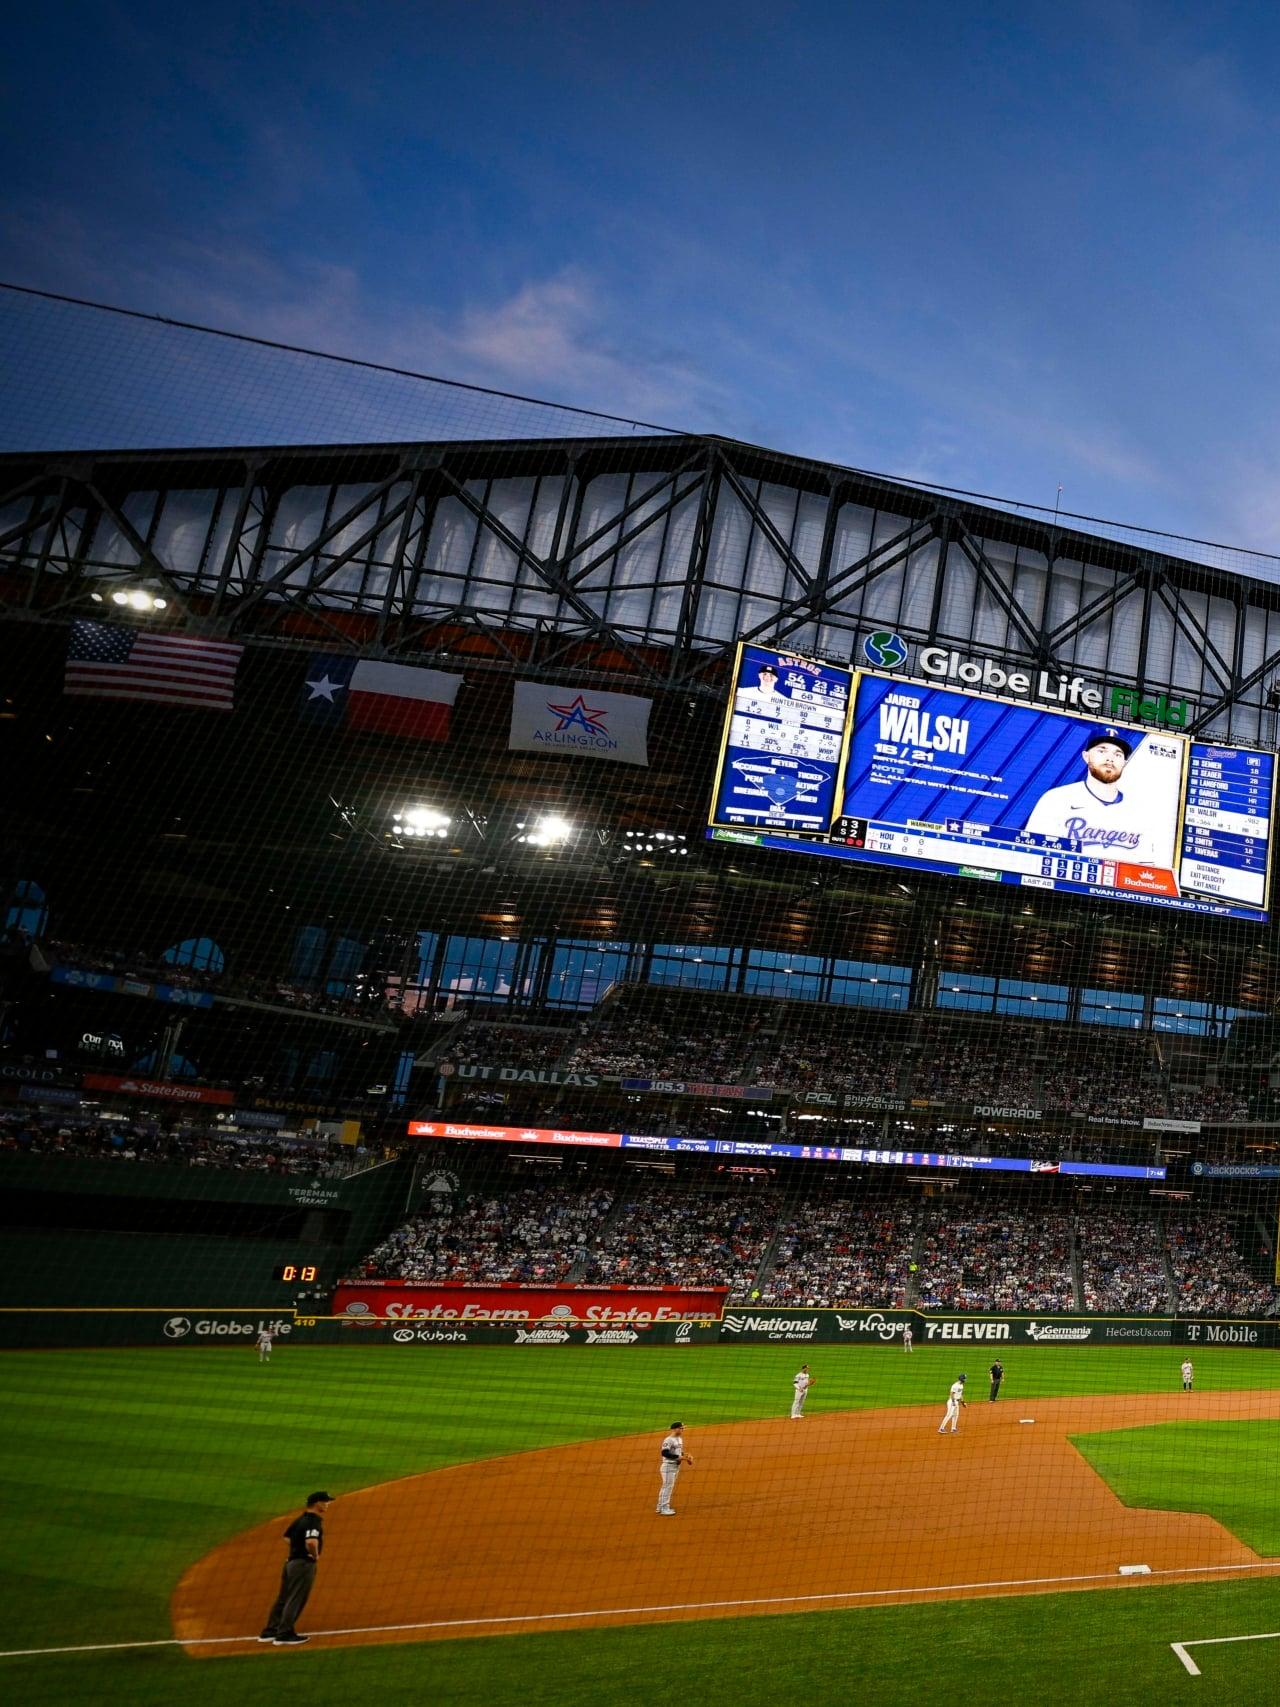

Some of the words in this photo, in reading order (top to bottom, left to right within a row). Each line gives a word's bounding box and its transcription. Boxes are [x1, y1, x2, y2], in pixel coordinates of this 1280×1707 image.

[778, 658, 822, 676] ASTROS
[788, 672, 805, 684] 54
[919, 647, 1031, 694] Globe
[1038, 671, 1102, 709] Life
[1110, 688, 1189, 727] Field
[884, 693, 921, 709] JARED
[879, 703, 970, 755] WALSH
[533, 730, 618, 749] ARLINGTON
[874, 743, 898, 755] 1B
[912, 750, 934, 762] 21
[872, 764, 904, 774] NOTE
[1198, 798, 1220, 809] CARTER
[1198, 808, 1217, 818] WALSH
[851, 820, 859, 829] 3
[841, 828, 846, 836] S
[850, 830, 858, 838] 2
[880, 831, 895, 841] HOU
[1065, 816, 1144, 848] Rangers
[879, 842, 892, 850] TEX
[1015, 836, 1036, 846] 5.40
[1042, 840, 1062, 850] 2.40
[1197, 864, 1220, 875] DISTANCE
[1023, 877, 1041, 886] LAST
[1190, 871, 1202, 880] EXIT
[1202, 873, 1226, 884] VELOCITY
[1124, 877, 1168, 891] Budweiser
[1193, 880, 1205, 888] EXIT
[1205, 882, 1221, 892] ANGLE
[1089, 887, 1116, 897] EVAN
[1115, 891, 1154, 903] CARTER
[1153, 898, 1196, 910] DOUBLED
[1209, 906, 1232, 914] LEFT
[2, 1065, 55, 1081] GOLD
[458, 1064, 494, 1079] UT
[500, 1068, 601, 1088] DALLAS
[650, 1081, 685, 1093] 105.3
[687, 1083, 713, 1094] THE
[716, 1084, 745, 1097] FAN
[805, 1092, 837, 1104] PGL
[973, 1106, 1043, 1120] POWERADE
[1088, 1115, 1104, 1124] Real
[1106, 1117, 1120, 1125] fans
[1121, 1118, 1141, 1126] know.
[445, 1125, 506, 1138] Budweiser
[553, 1132, 610, 1145] Budweiser
[963, 1156, 992, 1164] WALSH
[1208, 1164, 1261, 1176] Jackpocket
[288, 1188, 338, 1199] TEREMANA
[282, 1265, 318, 1282] 0:13
[195, 1320, 254, 1335] Globe
[257, 1319, 292, 1336] Life
[294, 1319, 316, 1327] 410
[743, 1317, 818, 1333] National
[859, 1313, 911, 1340] Kroger
[417, 1330, 467, 1341] Kubota
[528, 1330, 563, 1340] ARROW
[600, 1330, 632, 1340] ARROW
[1045, 1325, 1092, 1335] Germania
[1106, 1327, 1172, 1337] HeGetsUs.com
[1187, 1325, 1200, 1341] T
[1206, 1325, 1258, 1342] Mobile
